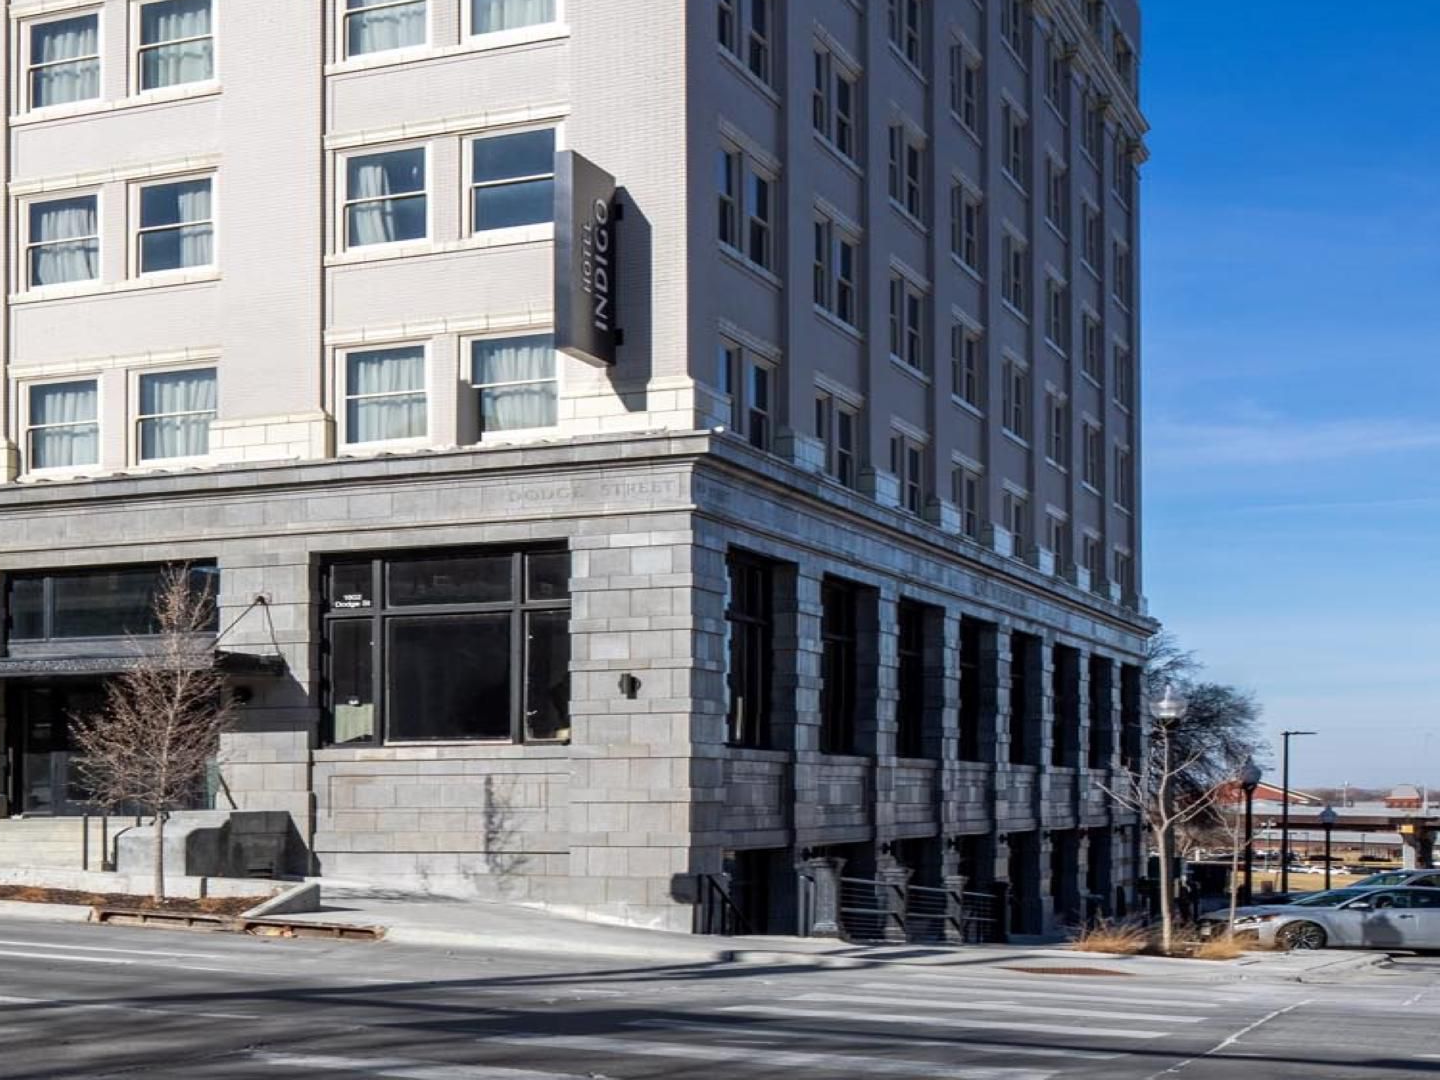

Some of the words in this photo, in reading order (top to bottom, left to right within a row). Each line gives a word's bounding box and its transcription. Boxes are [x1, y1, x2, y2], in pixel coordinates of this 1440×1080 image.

[583, 222, 592, 293] HOTEL
[594, 198, 609, 332] INDIGO
[600, 480, 677, 498] STREET
